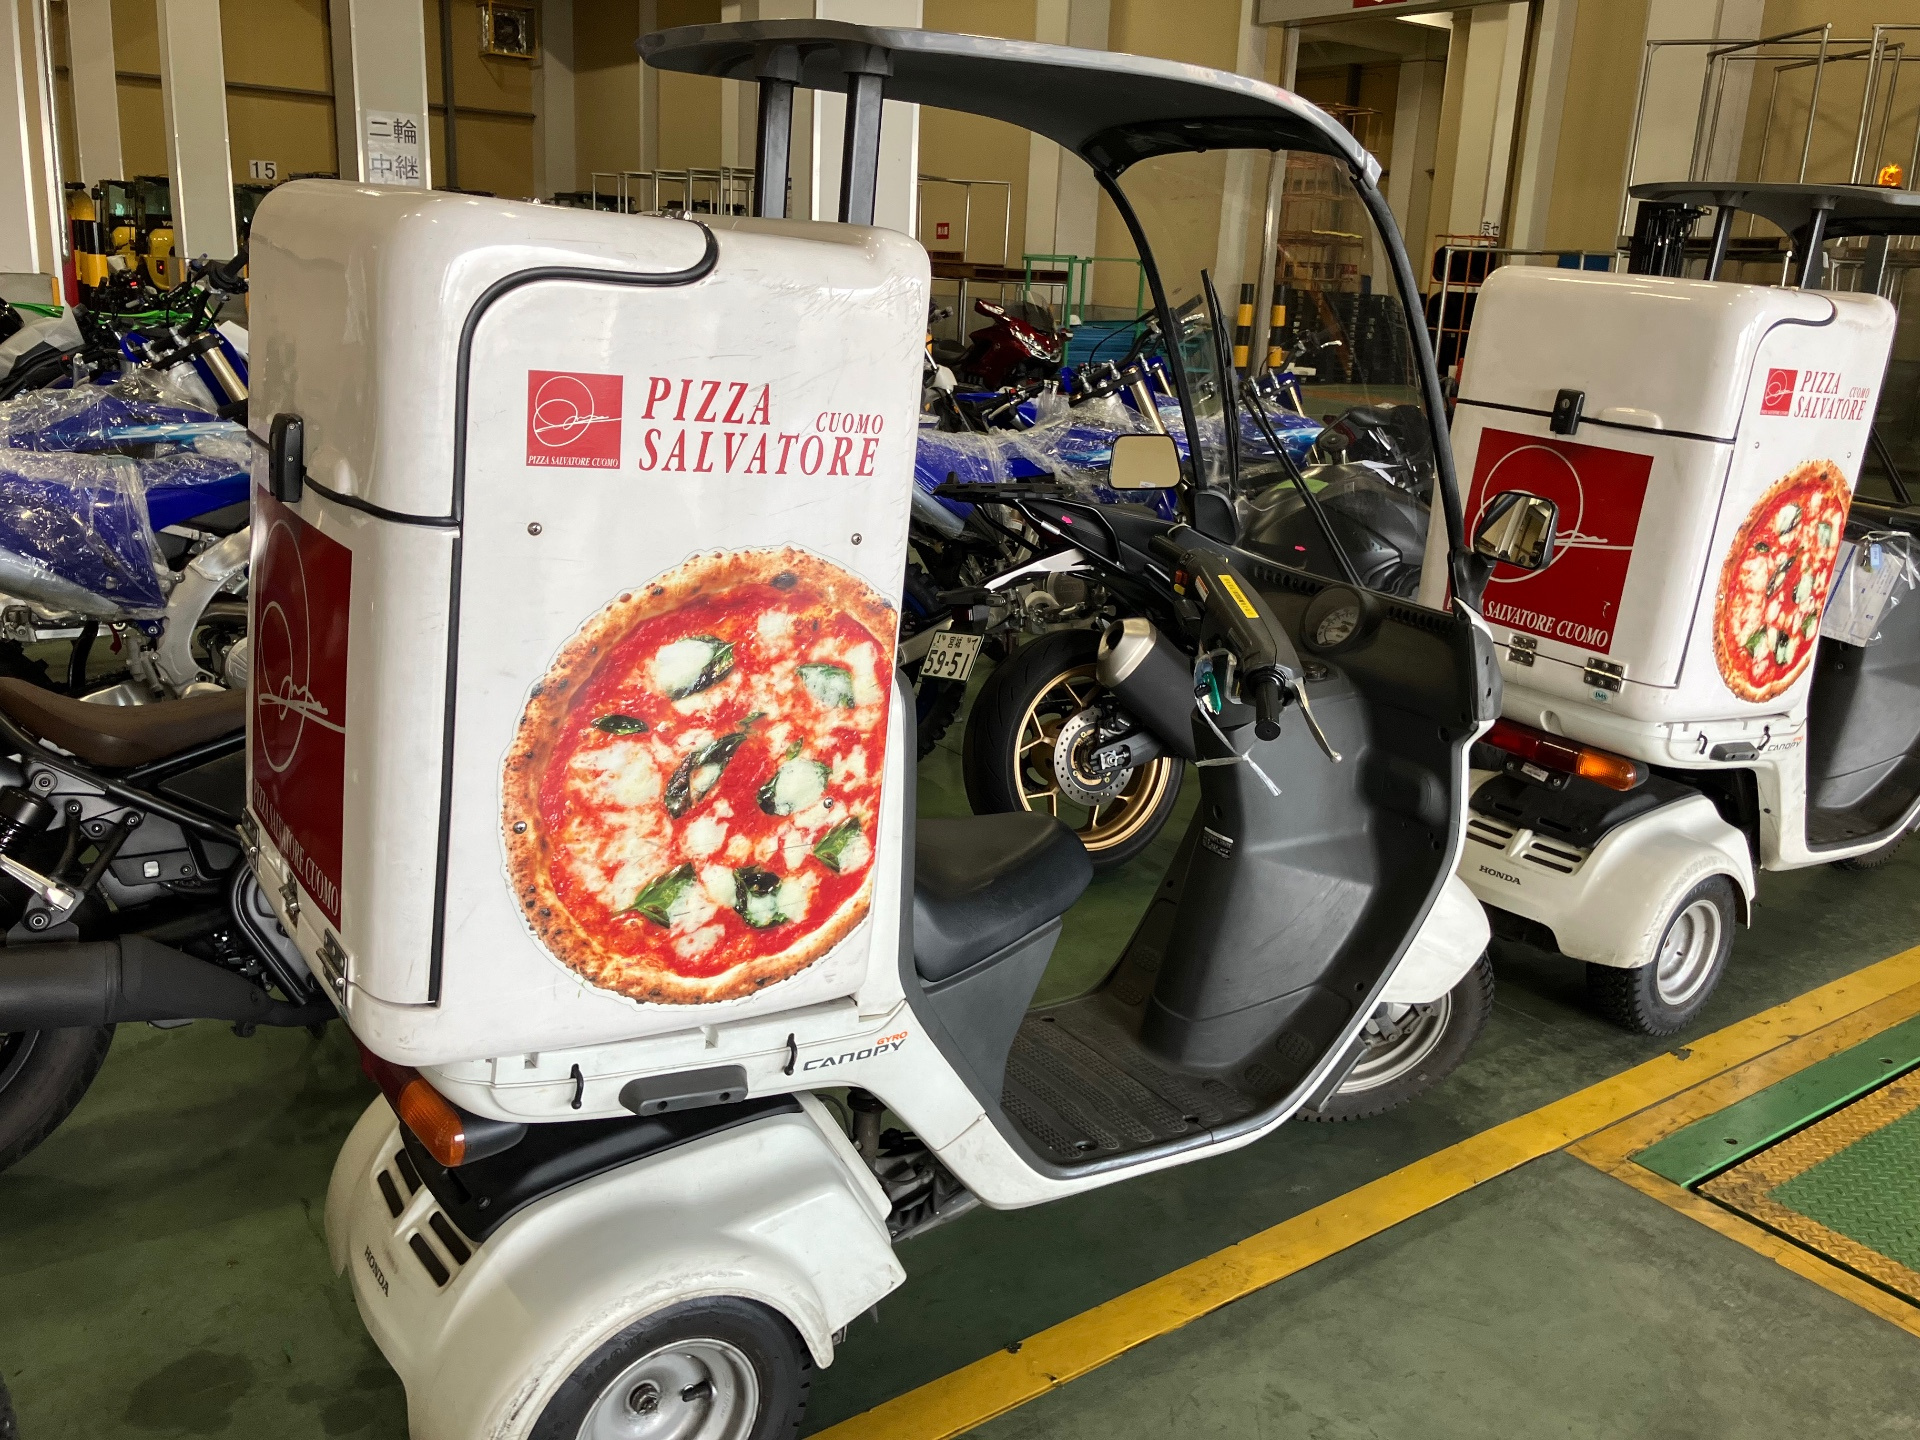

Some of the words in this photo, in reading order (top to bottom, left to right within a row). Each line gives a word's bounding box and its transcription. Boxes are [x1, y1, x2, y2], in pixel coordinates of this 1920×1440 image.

[369, 118, 417, 144] 二輪
[251, 161, 276, 179] 15
[371, 154, 419, 180] 中継
[1800, 370, 1841, 394] PIZZA
[1848, 386, 1870, 399] CUOMO
[641, 376, 771, 425] PIZZA
[1793, 396, 1866, 420] SALVATORE
[815, 411, 884, 434] CUOMO
[527, 455, 549, 465] PIZZA
[550, 455, 591, 466] SALVATORE
[591, 457, 619, 467] CUOMO
[638, 427, 880, 476] SALVATORE
[1485, 600, 1556, 634] SALVATORE
[1556, 620, 1609, 648] CUOMO
[305, 856, 339, 917] CUOMO
[1479, 865, 1521, 885] HONDA
[876, 1031, 908, 1045] GYRO
[803, 1039, 906, 1071] CANOPY
[365, 1244, 389, 1297] HONDA
